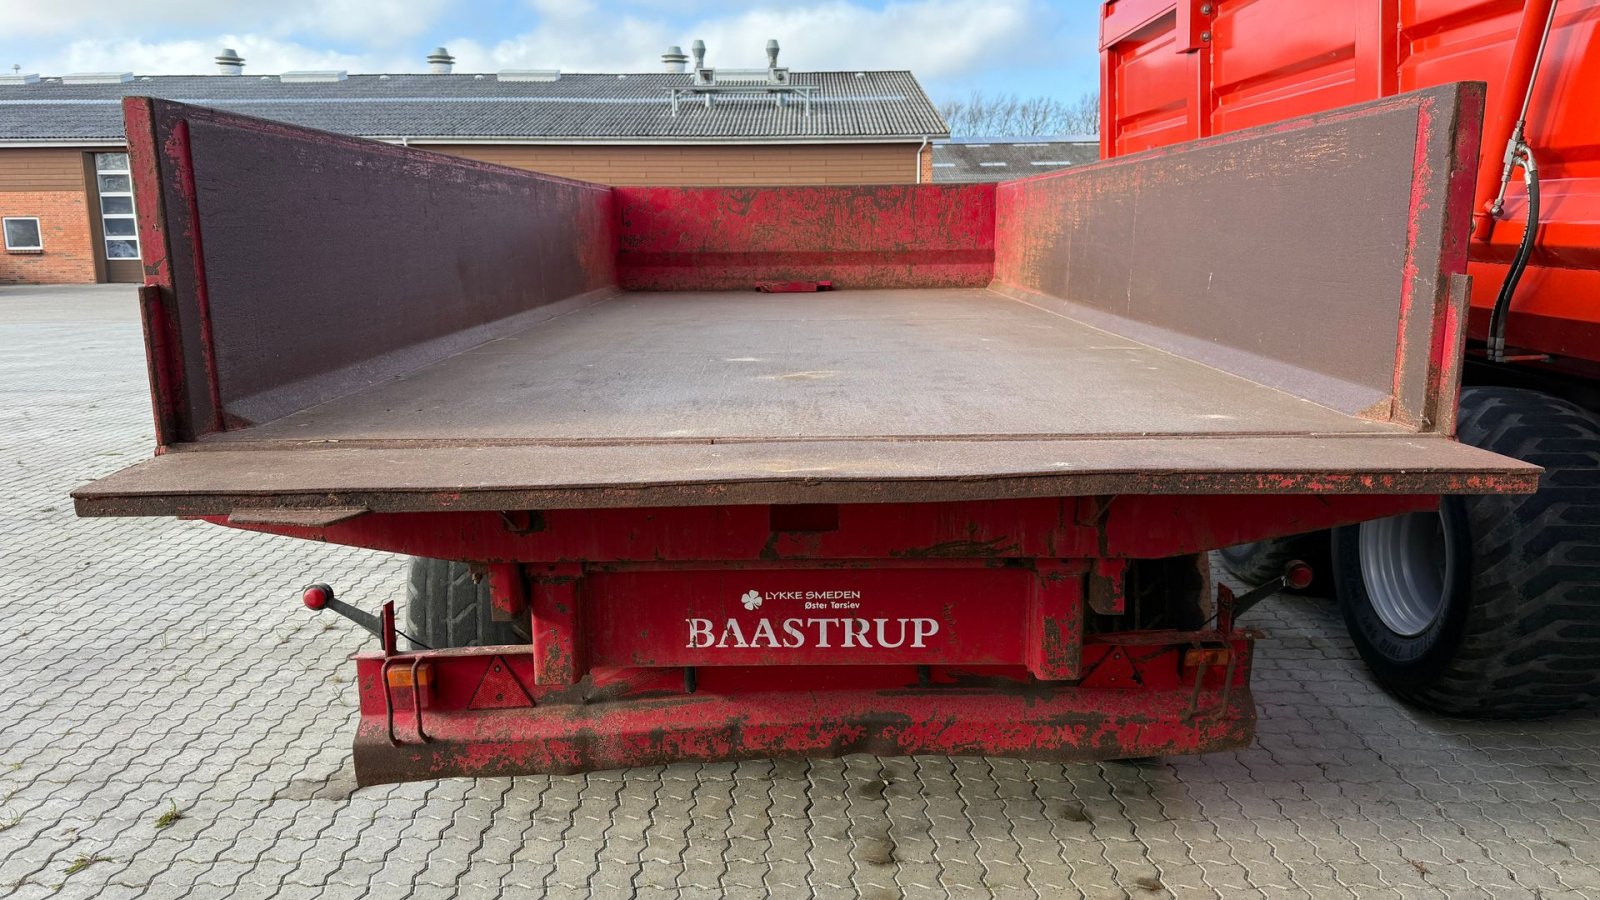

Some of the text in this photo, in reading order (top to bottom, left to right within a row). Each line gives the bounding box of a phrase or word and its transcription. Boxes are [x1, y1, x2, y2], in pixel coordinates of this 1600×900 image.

[765, 590, 861, 600] LYKKE SMEDEN
[804, 601, 828, 610] Øster
[685, 617, 939, 648] BAASTRUP
